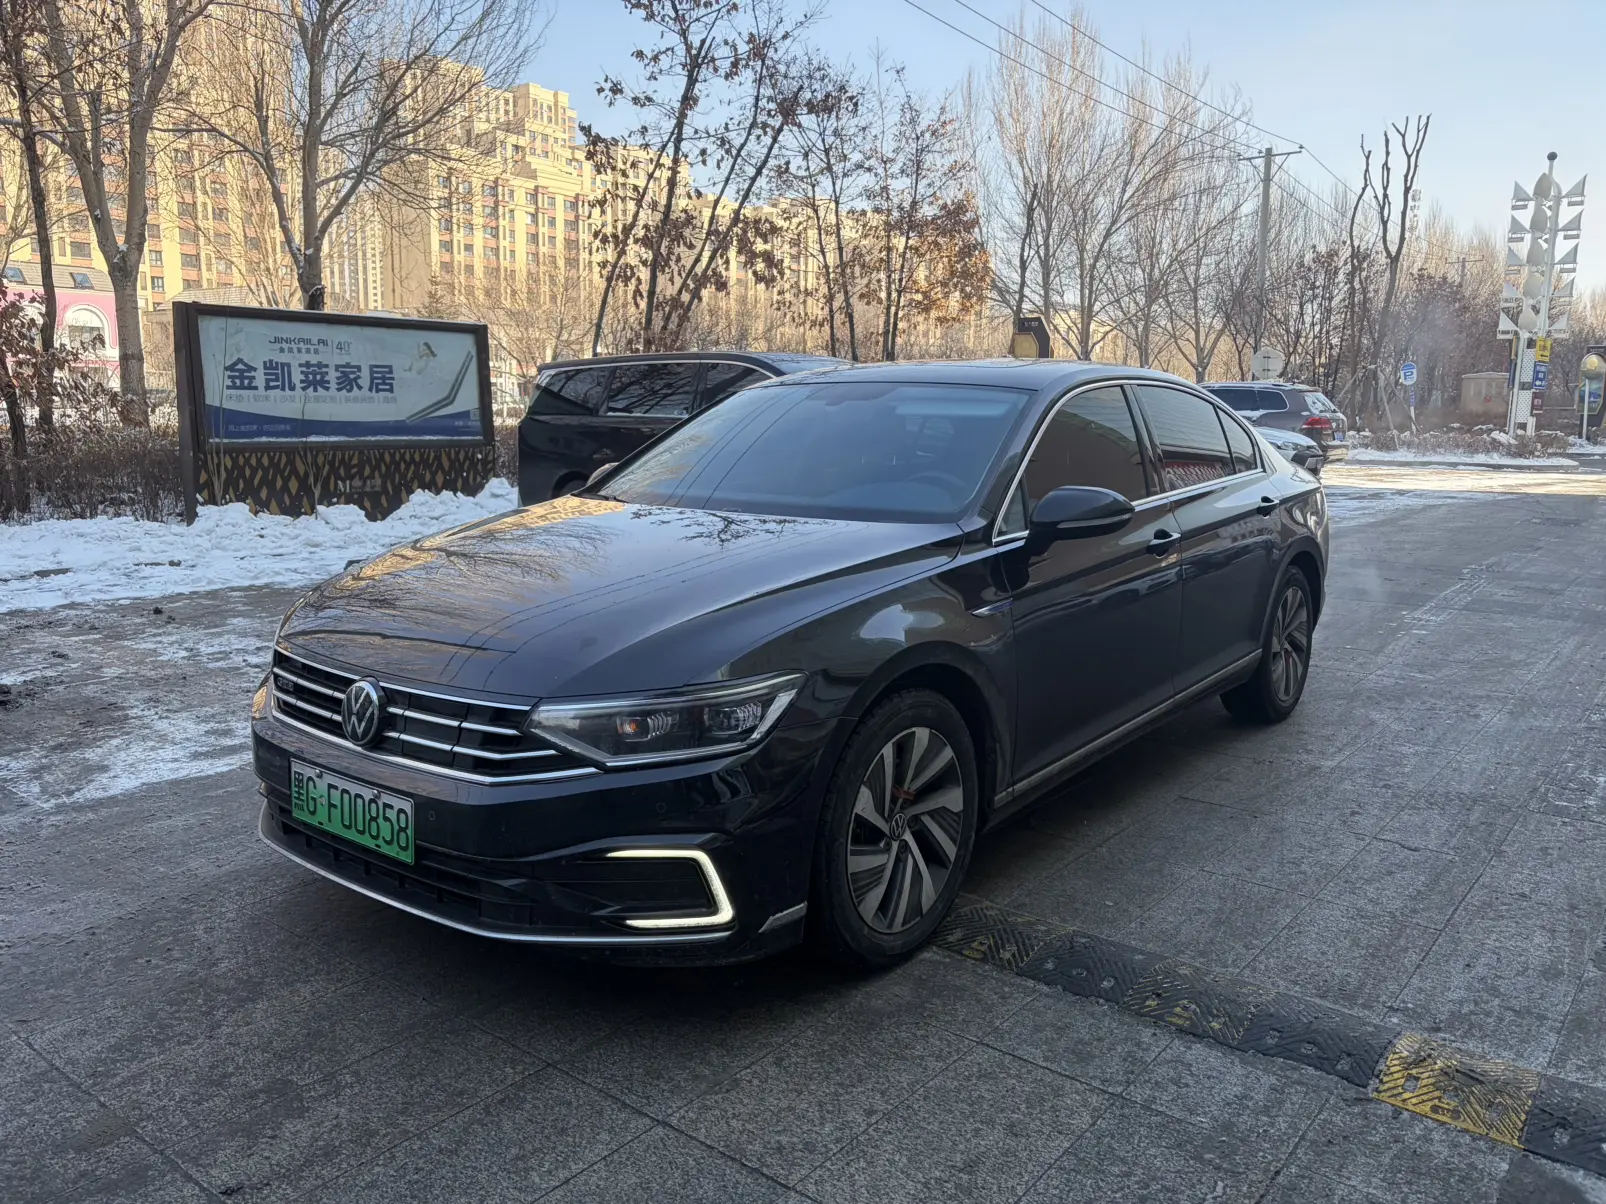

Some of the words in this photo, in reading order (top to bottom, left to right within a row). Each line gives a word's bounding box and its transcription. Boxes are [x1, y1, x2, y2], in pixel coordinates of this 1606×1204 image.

[268, 336, 329, 347] JINKAILAI
[224, 357, 396, 394] 金凯莱家居
